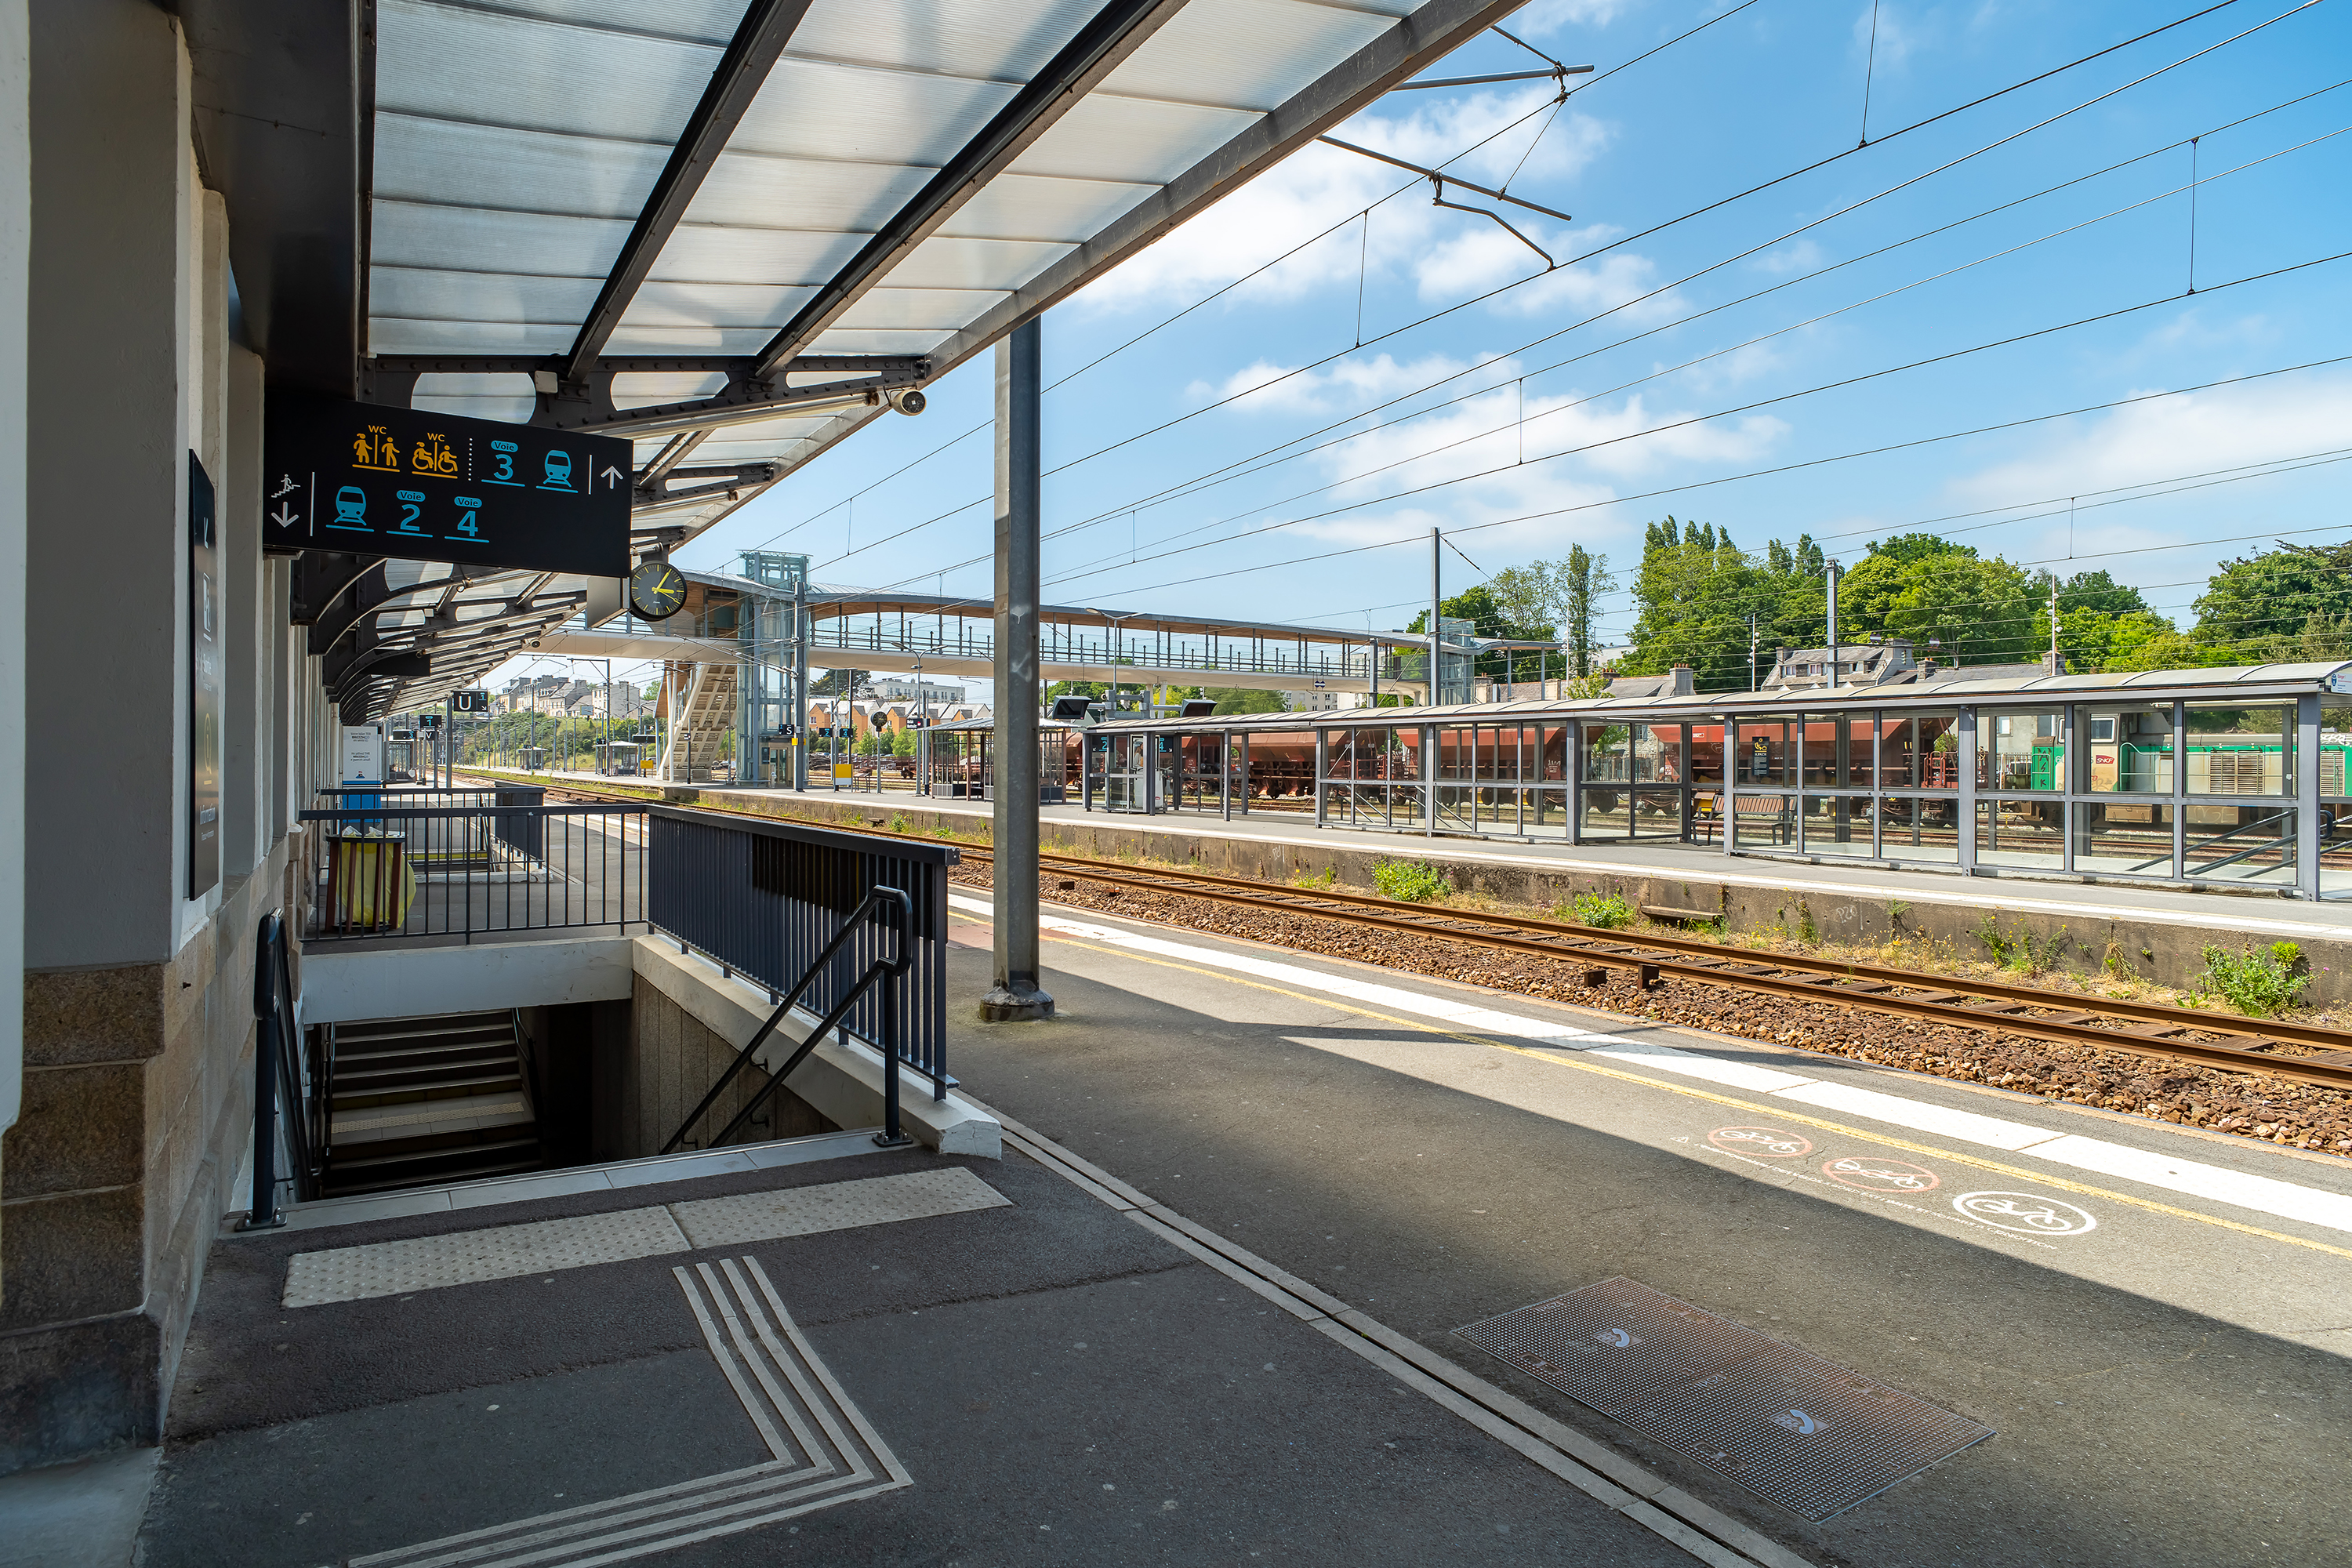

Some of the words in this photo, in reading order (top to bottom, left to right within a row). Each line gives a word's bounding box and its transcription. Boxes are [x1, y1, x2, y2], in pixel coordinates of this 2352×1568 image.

[368, 424, 387, 434] WC
[427, 432, 445, 442] WC
[494, 441, 514, 451] Voie
[493, 454, 514, 480] 3
[400, 492, 421, 500] Voie
[458, 498, 478, 506] Voie
[400, 503, 420, 531] 2
[457, 510, 478, 536] 4
[459, 695, 472, 710] U
[786, 726, 793, 735] S
[1102, 741, 1107, 750] 2
[1160, 742, 1164, 750] 4
